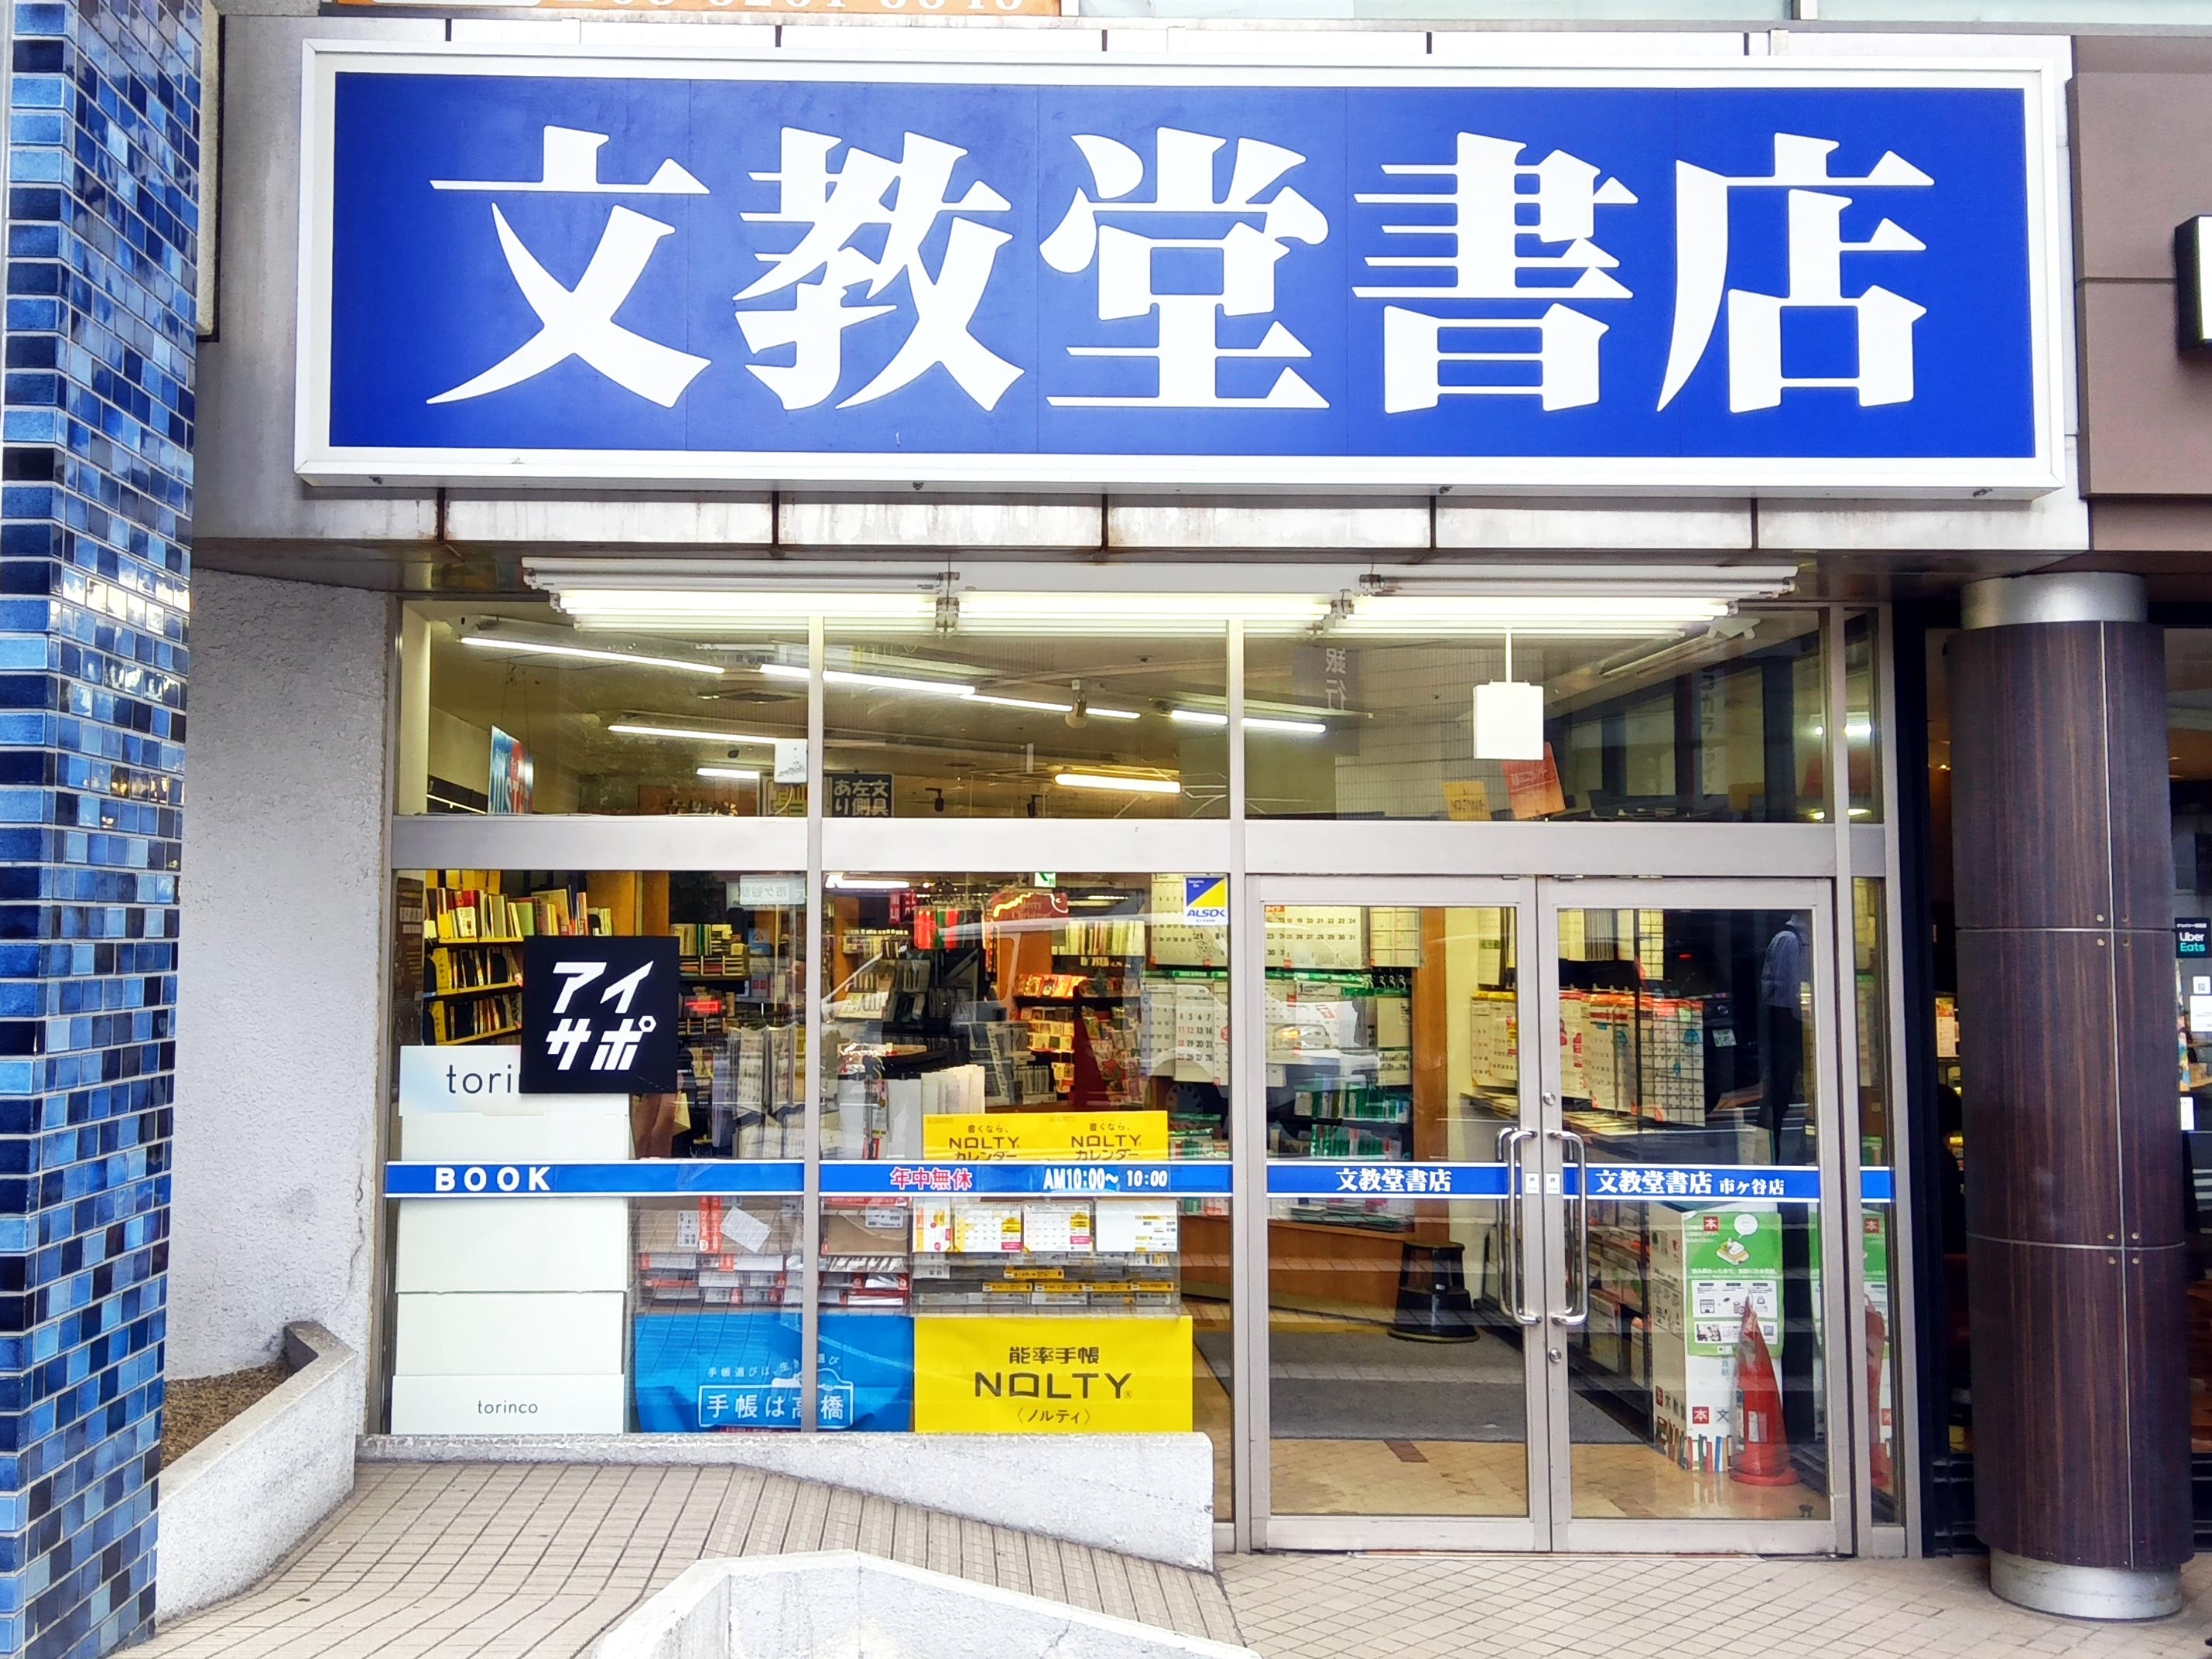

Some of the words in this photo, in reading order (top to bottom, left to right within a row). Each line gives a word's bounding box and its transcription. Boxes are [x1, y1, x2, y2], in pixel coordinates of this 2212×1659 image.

[426, 125, 1934, 413] 文教堂書店
[2179, 932, 2204, 942] Uber
[2180, 942, 2206, 952] Eats
[552, 960, 654, 1014] アイ
[546, 1015, 656, 1070] サポ
[447, 1064, 520, 1093] tori
[1076, 1149, 1139, 1160] カレンダー
[435, 1166, 551, 1192] BOOK
[889, 1167, 973, 1190] 年中無休
[1126, 1170, 1168, 1188] 10:00
[1336, 1168, 1452, 1192] 文教堂書店
[1594, 1170, 1713, 1195] 文教堂書店
[1008, 1346, 1100, 1364] 能率手帳
[477, 1399, 539, 1414] torinco
